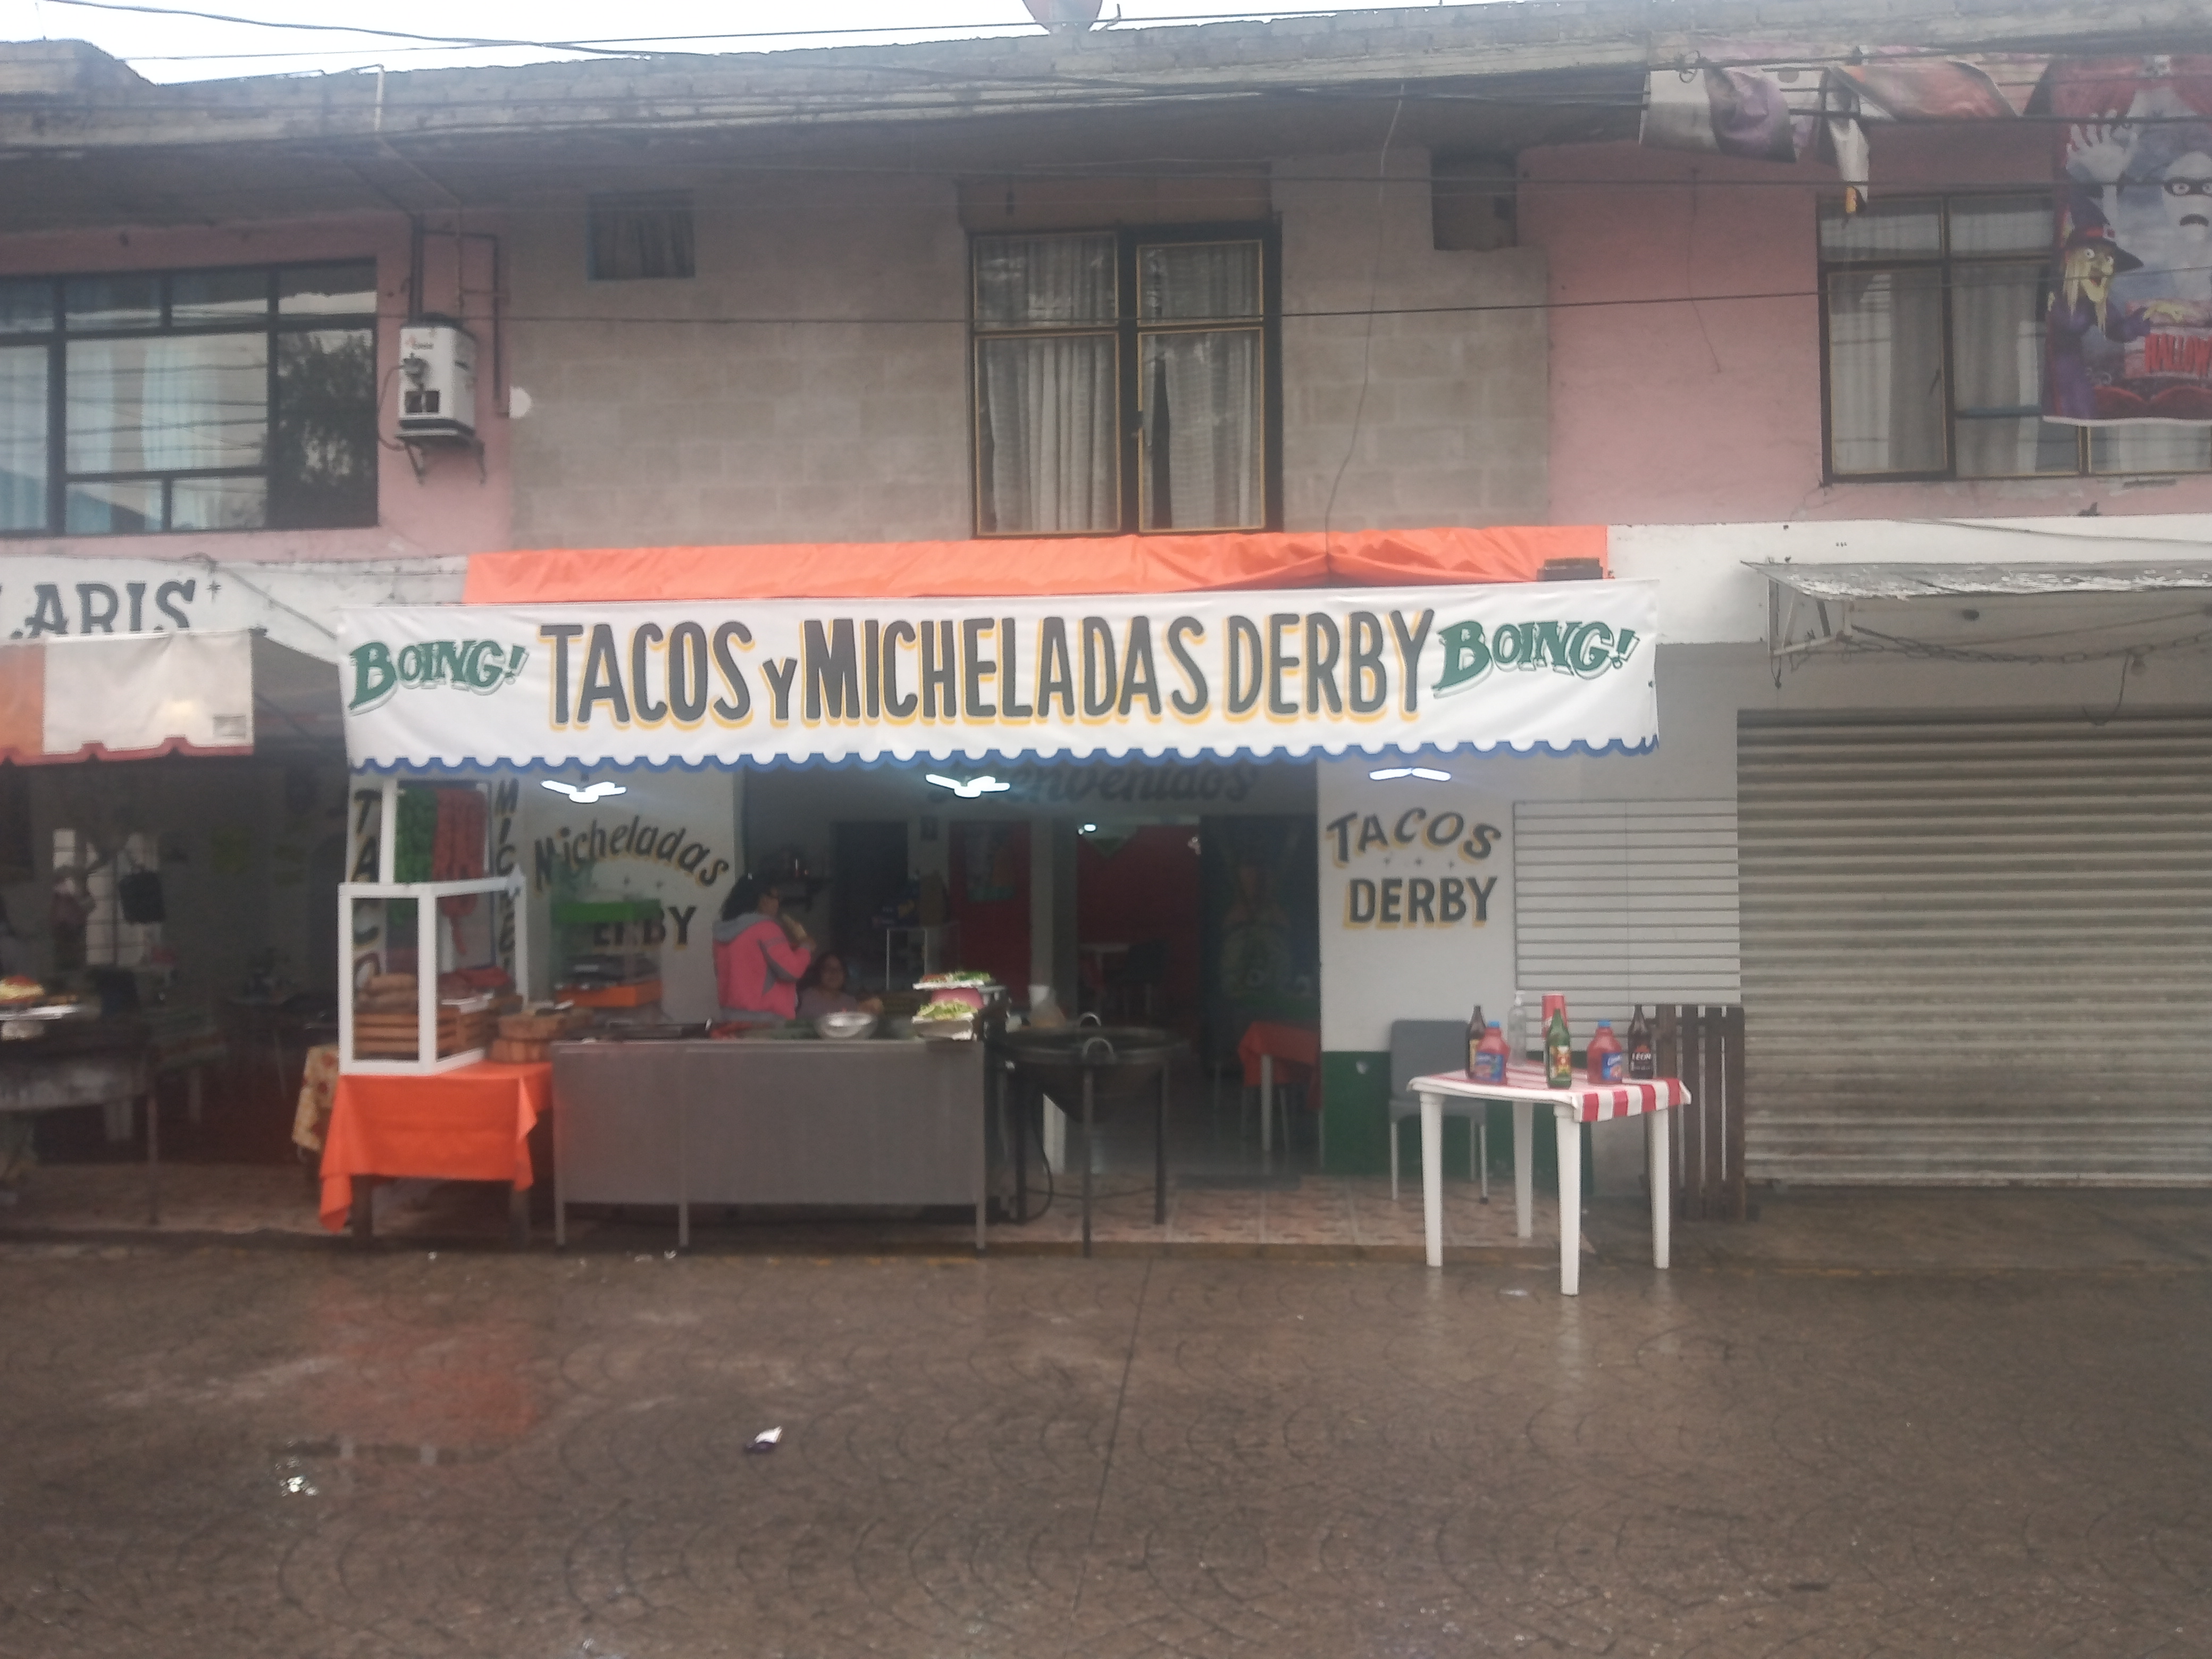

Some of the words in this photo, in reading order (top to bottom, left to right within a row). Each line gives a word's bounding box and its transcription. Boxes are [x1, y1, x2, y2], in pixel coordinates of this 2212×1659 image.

[0, 580, 197, 639] ARIS
[348, 640, 529, 715] BOING!
[538, 621, 755, 732] TACOS
[759, 656, 797, 728] Y
[800, 615, 1212, 726] MICHELADAS
[1224, 609, 1434, 723] DERBY
[1432, 620, 1640, 700] BOING!
[534, 815, 730, 896] Micheladas
[1325, 807, 1502, 869] TACOS
[1343, 877, 1497, 929] DERBY
